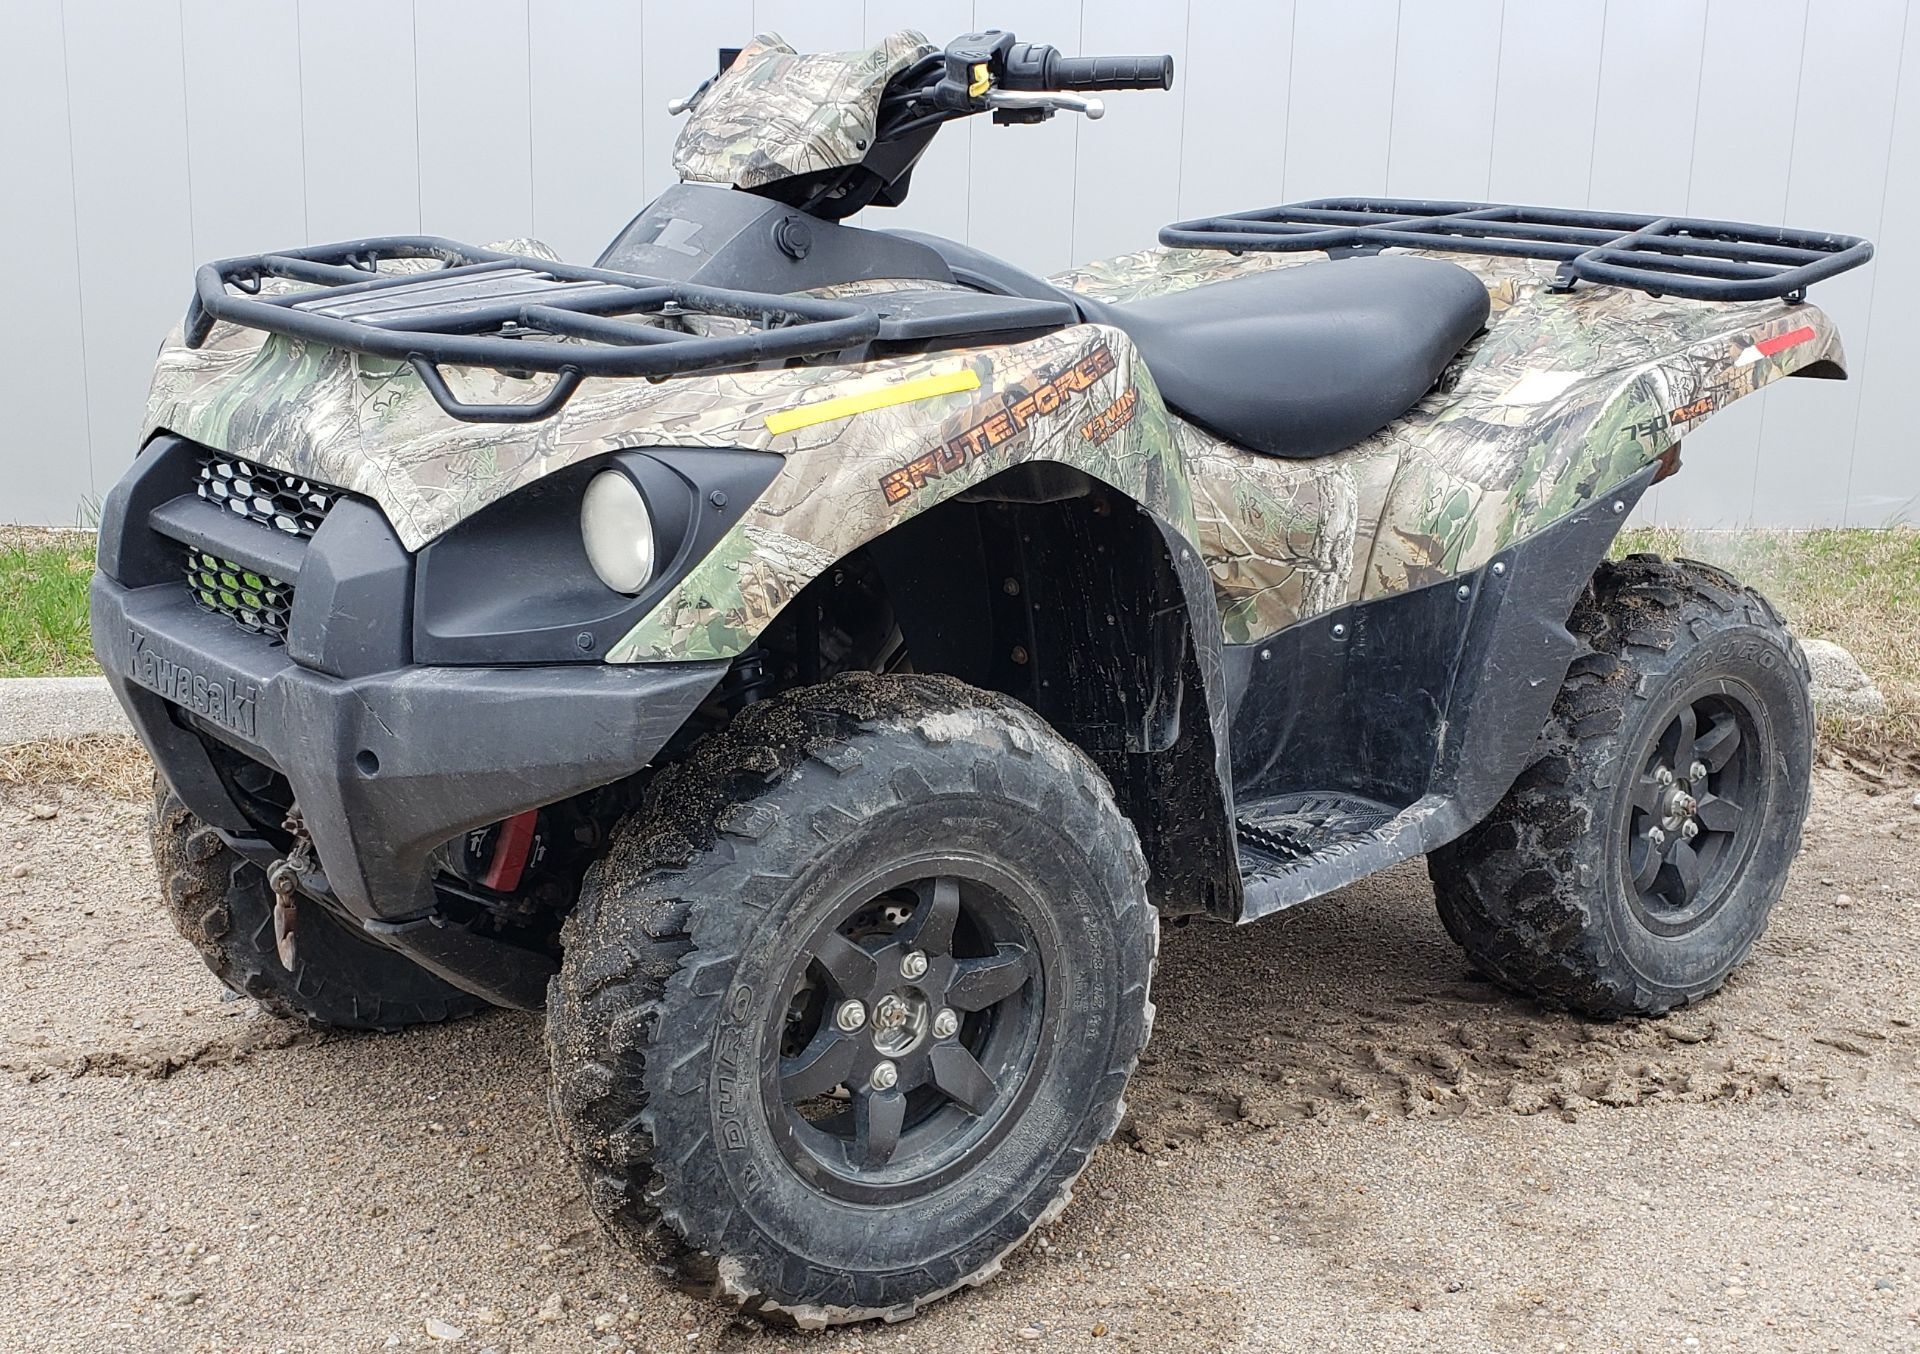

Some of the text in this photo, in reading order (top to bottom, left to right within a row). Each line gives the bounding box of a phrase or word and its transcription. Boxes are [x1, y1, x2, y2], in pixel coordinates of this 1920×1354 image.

[879, 409, 1018, 506] BRUTE
[1011, 344, 1116, 434] FORCE
[1080, 388, 1137, 442] V-TWIN
[1621, 414, 1668, 440] 750
[127, 628, 256, 737] Kawasaki
[1695, 639, 1776, 673] DURO
[720, 986, 751, 1150] DURO
